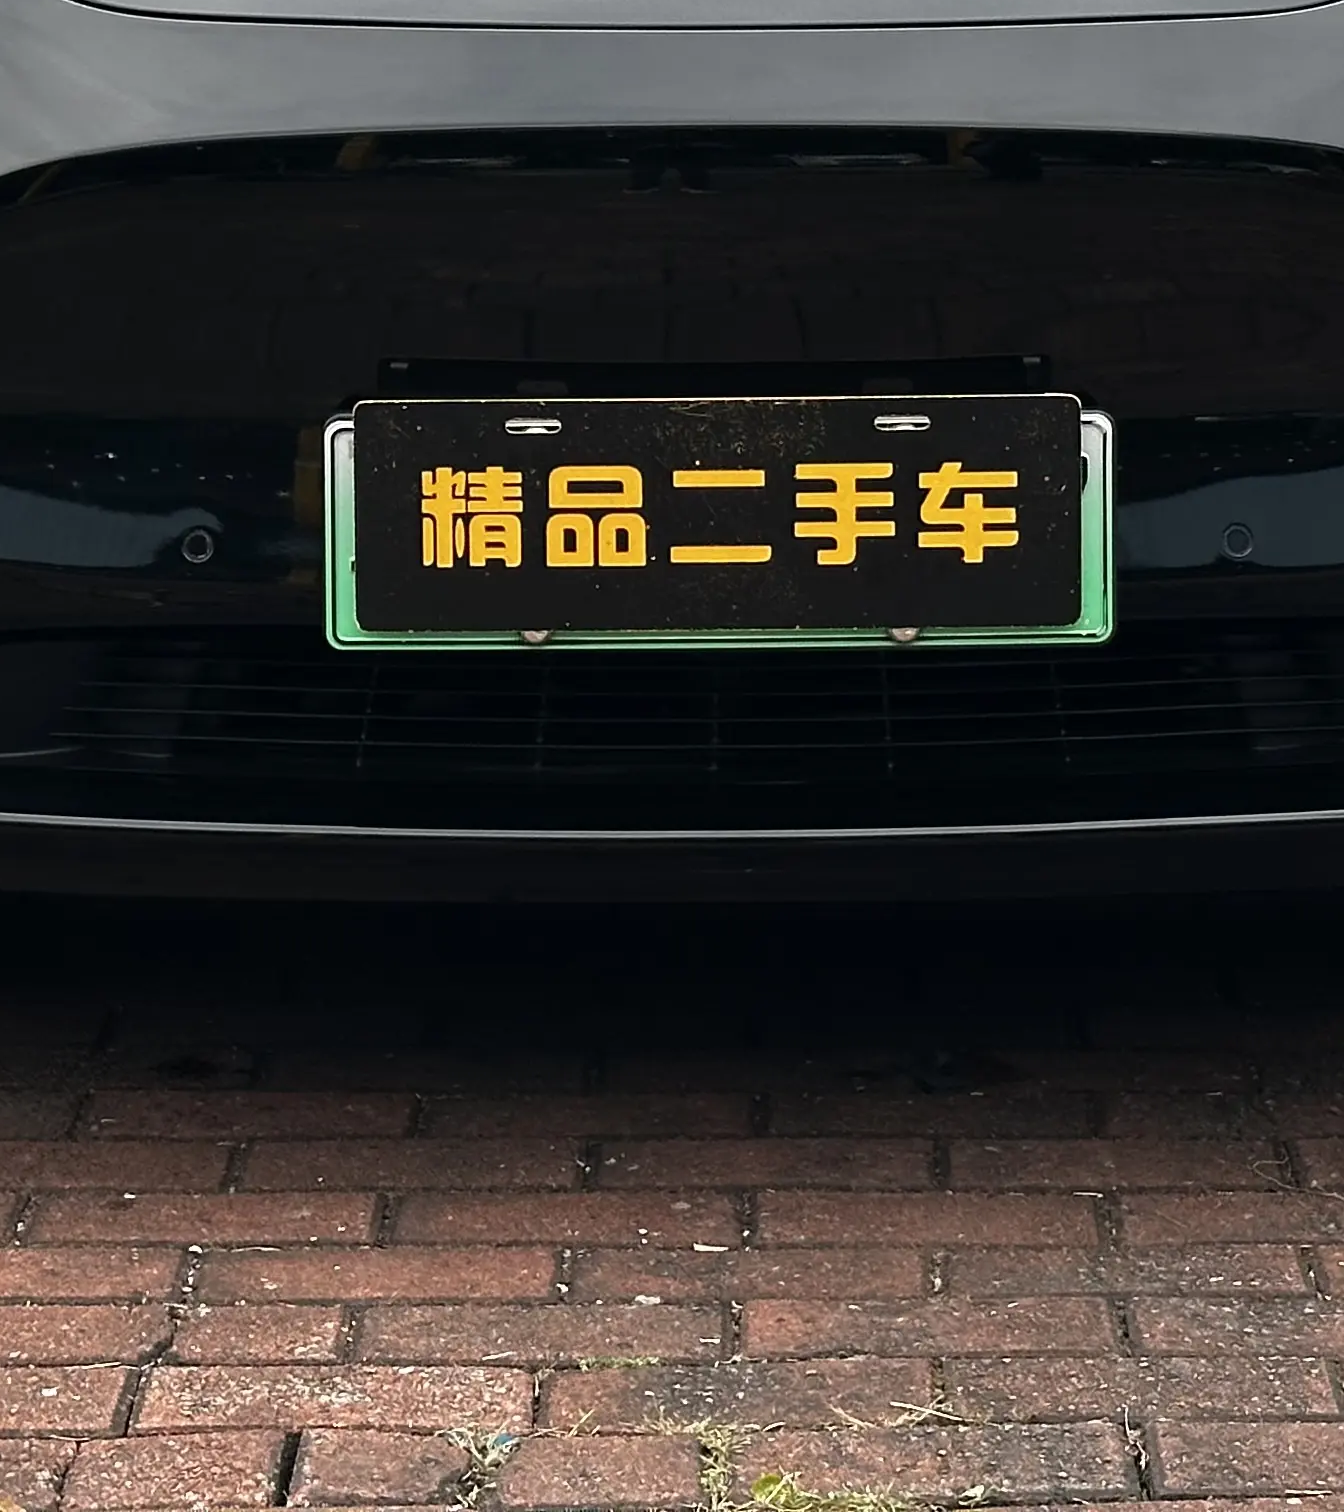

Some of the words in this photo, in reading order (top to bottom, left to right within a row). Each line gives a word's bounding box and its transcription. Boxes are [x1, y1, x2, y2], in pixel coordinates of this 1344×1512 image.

[421, 462, 1020, 568] 精品二手车
